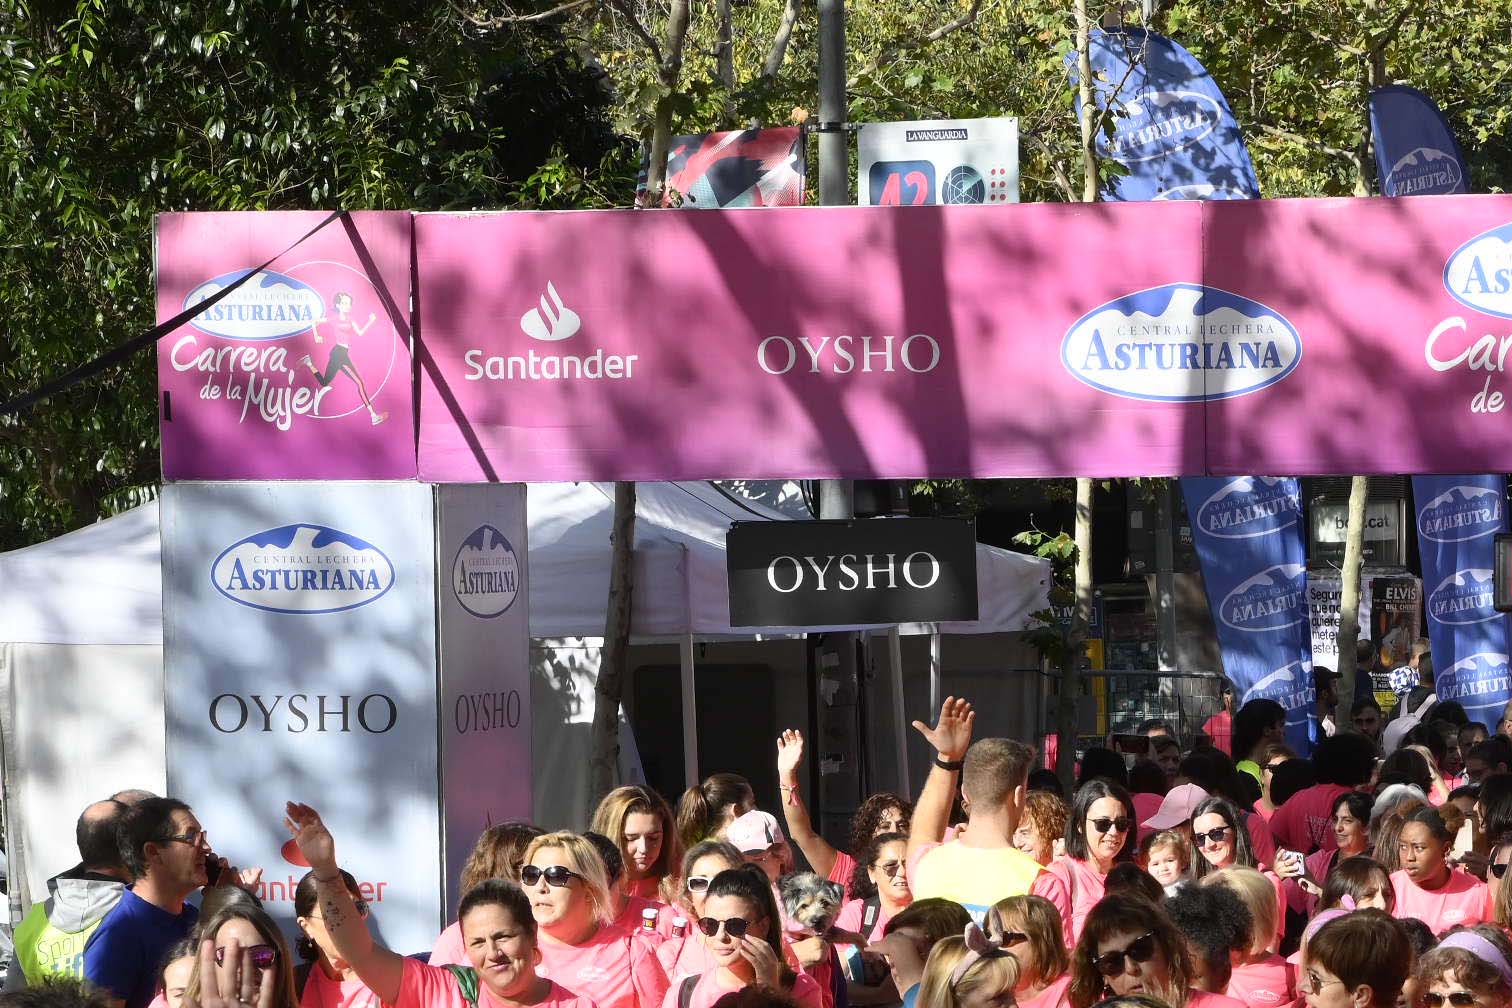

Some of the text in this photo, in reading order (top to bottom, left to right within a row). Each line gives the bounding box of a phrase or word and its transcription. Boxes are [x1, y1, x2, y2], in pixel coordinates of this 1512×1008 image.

[1082, 328, 1283, 370] ASTURIANA
[1117, 324, 1274, 337] CENTRAL LECHERA
[171, 335, 287, 372] Carrera
[464, 349, 638, 380] Santander
[757, 334, 940, 374] OYSHO
[200, 370, 332, 431] de la Mujer
[1471, 375, 1505, 414] de
[226, 558, 382, 591] ASTURIANA
[254, 554, 375, 564] CENTRAL LECHERA
[457, 559, 516, 595] ASTURIANA
[767, 551, 940, 593] OYSHO
[1312, 604, 1327, 614] que
[1386, 587, 1416, 600] ELVIS
[209, 693, 397, 733] OYSHO
[455, 690, 521, 734] OYSHO
